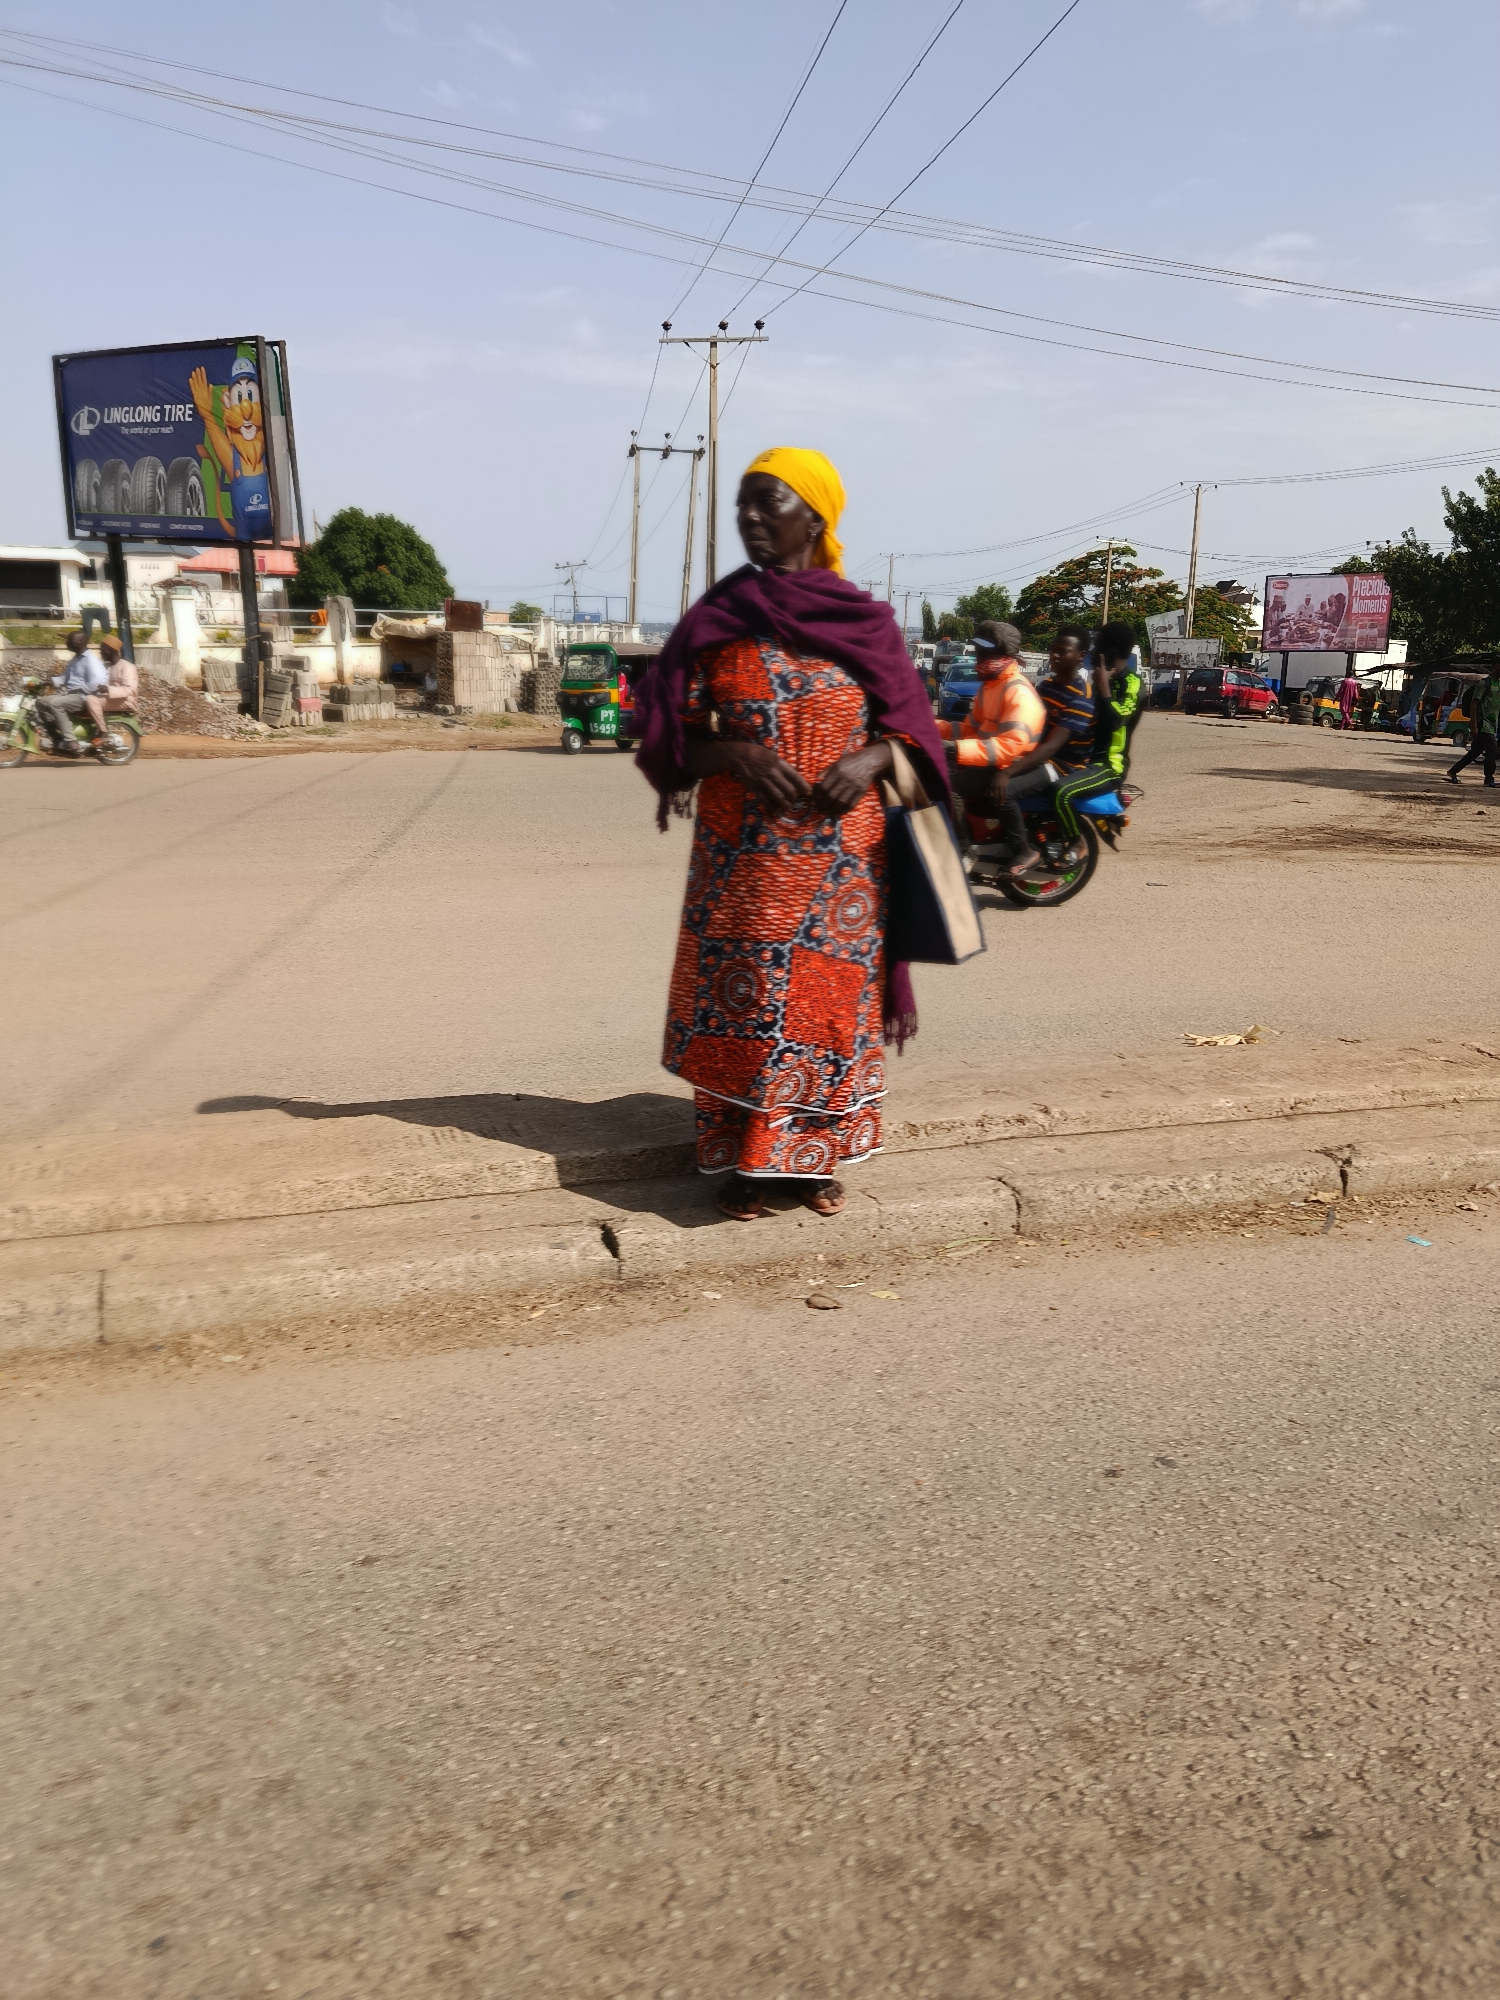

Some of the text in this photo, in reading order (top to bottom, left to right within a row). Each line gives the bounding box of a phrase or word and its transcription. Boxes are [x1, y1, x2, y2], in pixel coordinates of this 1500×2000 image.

[104, 404, 193, 423] LINGLONG TIRE
[130, 425, 143, 435] world
[149, 427, 160, 436] your
[160, 425, 174, 434] reach
[245, 504, 268, 512] LINGLONG
[1352, 576, 1390, 596] Precious
[1352, 597, 1387, 613] Moments
